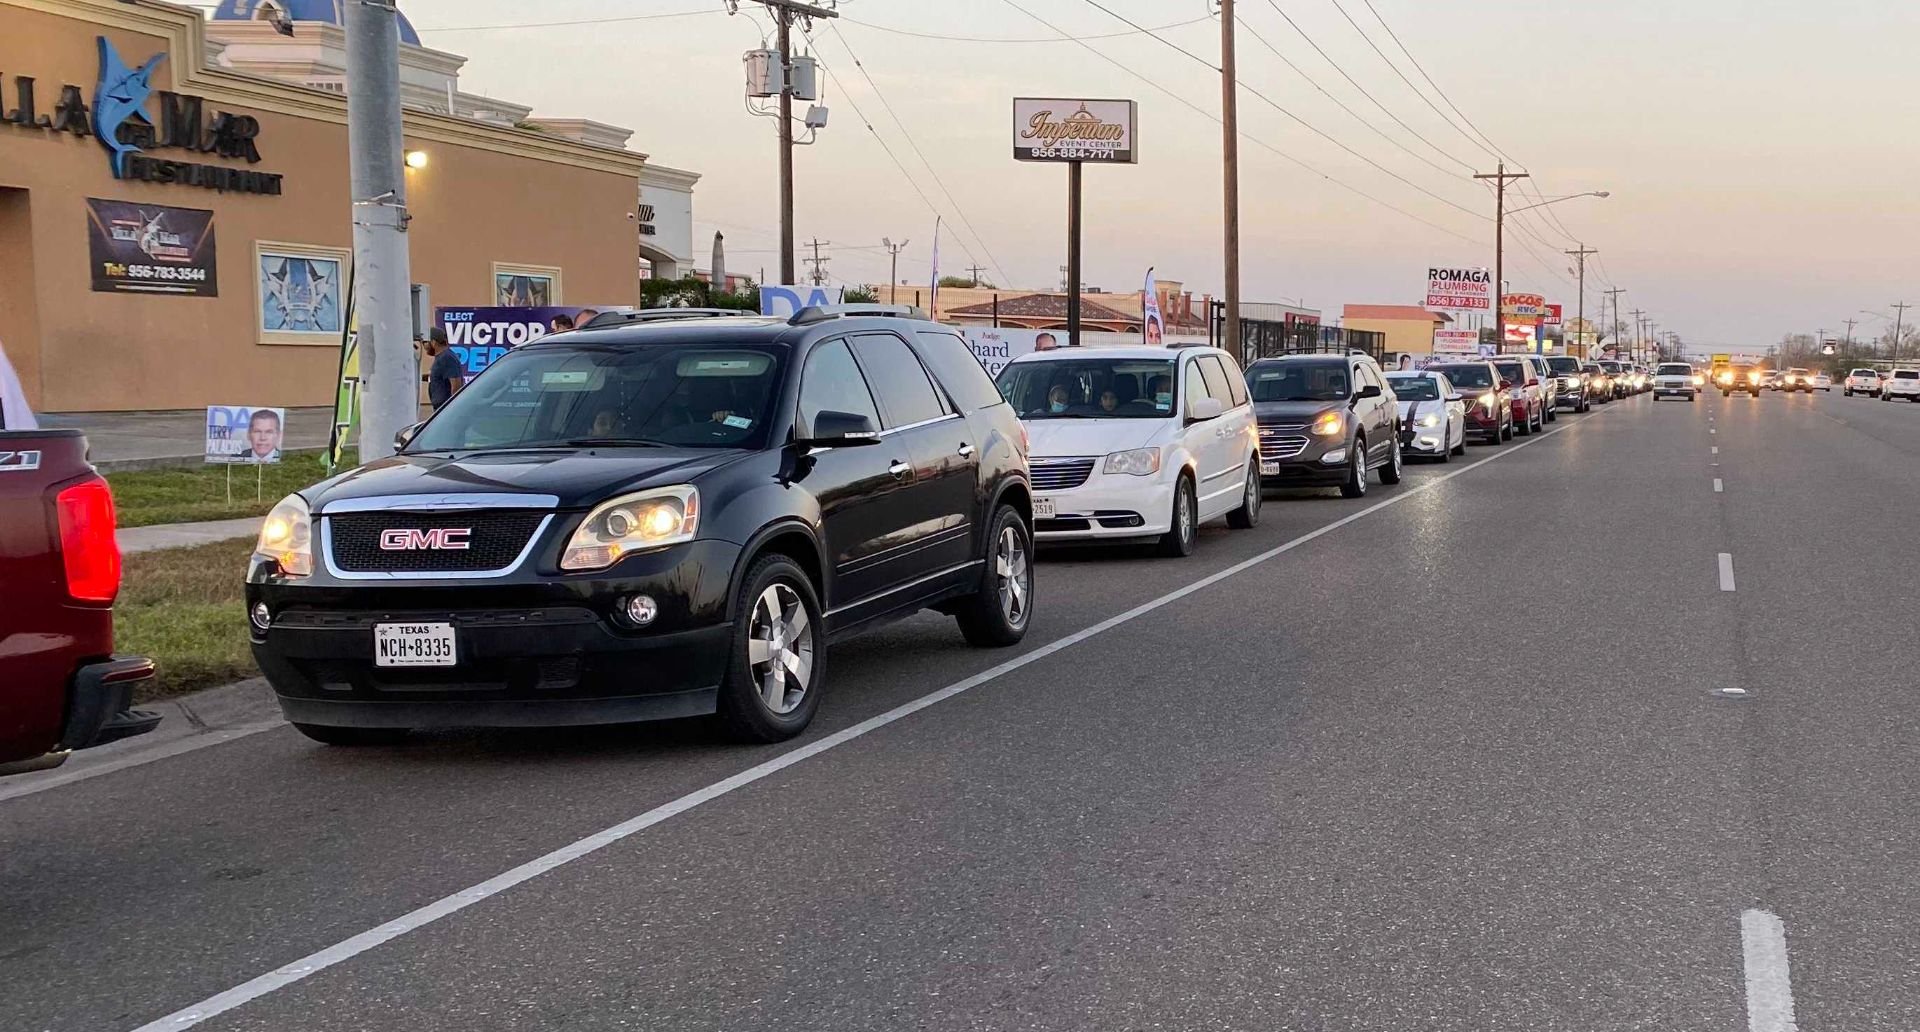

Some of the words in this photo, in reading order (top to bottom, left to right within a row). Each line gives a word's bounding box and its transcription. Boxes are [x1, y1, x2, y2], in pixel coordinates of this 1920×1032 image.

[1089, 141, 1122, 149] CENTER
[1031, 148, 1115, 159] 956-884-7171
[128, 265, 206, 280] 956-783-3544
[1428, 268, 1490, 283] ROMAGA
[1431, 280, 1487, 292] PLUMBING
[1428, 296, 1450, 307] (956)
[1450, 297, 1488, 309] 787-1331
[1501, 295, 1543, 307] TACOS
[1517, 306, 1538, 314] RVG
[443, 312, 475, 321] ELECT
[970, 340, 1010, 358] hard
[208, 425, 233, 440] TERRY
[379, 528, 471, 550] GMC
[399, 625, 430, 635] TEXAS
